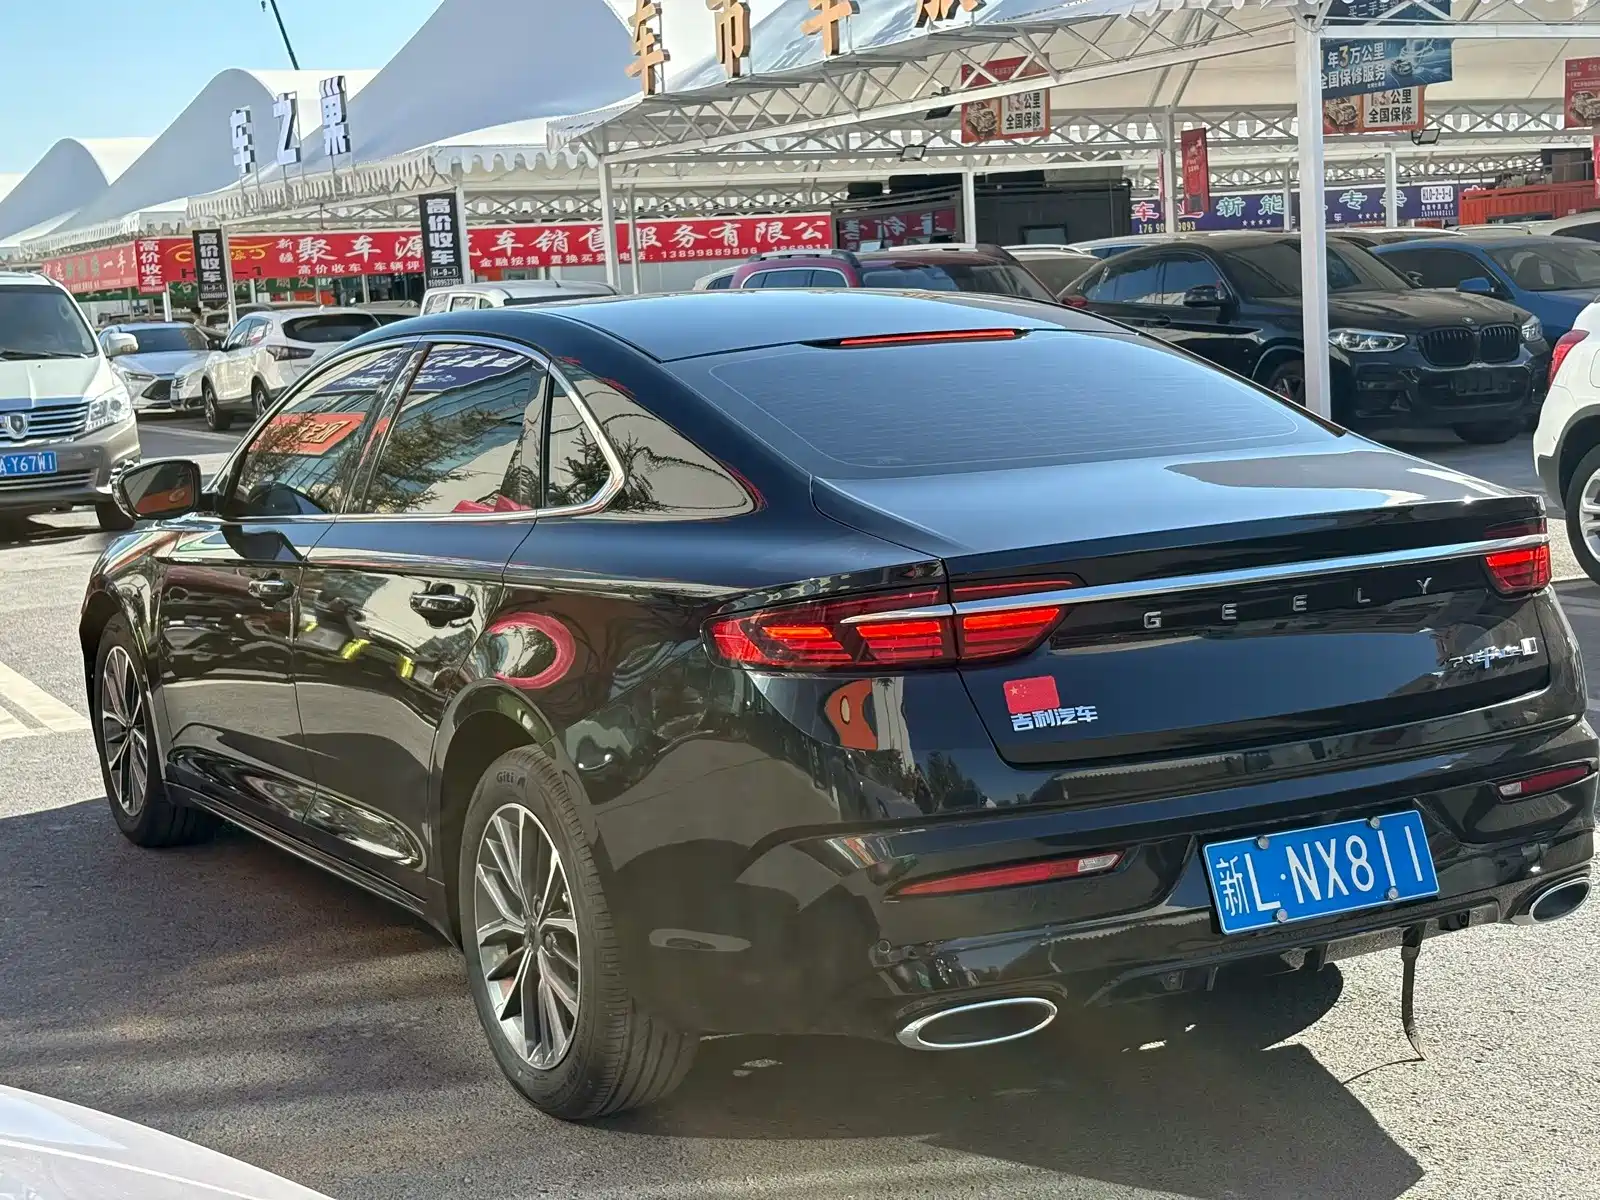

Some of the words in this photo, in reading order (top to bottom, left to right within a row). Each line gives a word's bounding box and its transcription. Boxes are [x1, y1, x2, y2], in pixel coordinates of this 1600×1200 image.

[1320, 64, 1386, 90] 全国保修服务
[1006, 112, 1041, 130] 全国保修
[1368, 106, 1412, 124] 全国保修
[426, 198, 455, 265] 高价收车
[138, 240, 163, 287] 高价收车
[198, 232, 221, 283] 高价收车
[297, 261, 362, 276] 高价收车
[479, 255, 540, 268] 金融按揭
[1143, 577, 1432, 629] GEELY
[1010, 705, 1098, 731] 吉利汽车
